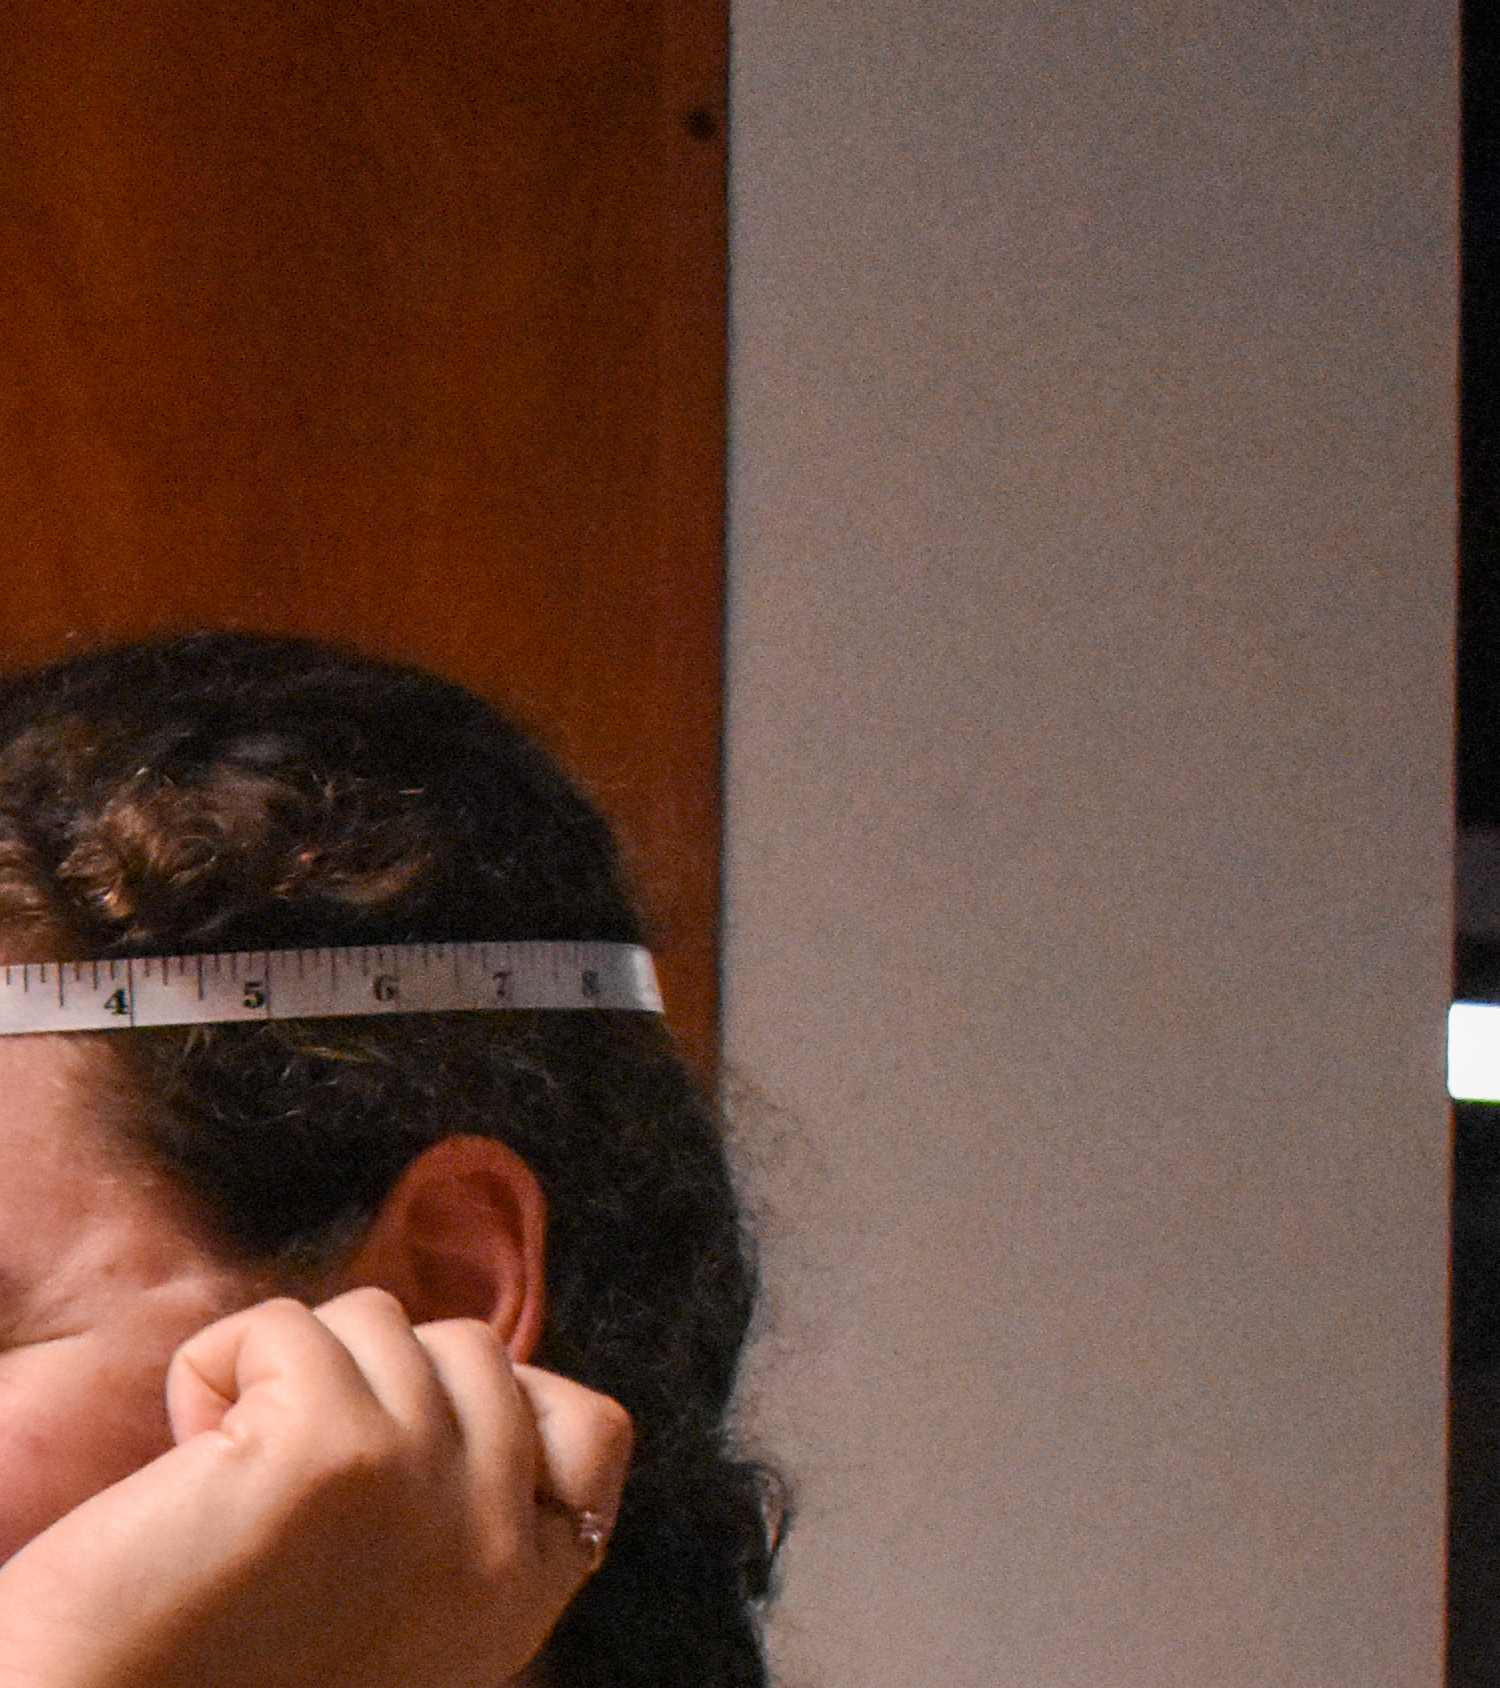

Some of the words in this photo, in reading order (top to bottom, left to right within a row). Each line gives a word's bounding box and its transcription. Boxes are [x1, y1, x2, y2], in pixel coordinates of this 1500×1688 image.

[103, 988, 130, 1016] 4
[242, 981, 265, 1010] 5
[373, 974, 397, 1003] 6
[492, 971, 511, 1000] 7
[581, 971, 599, 998] 8
